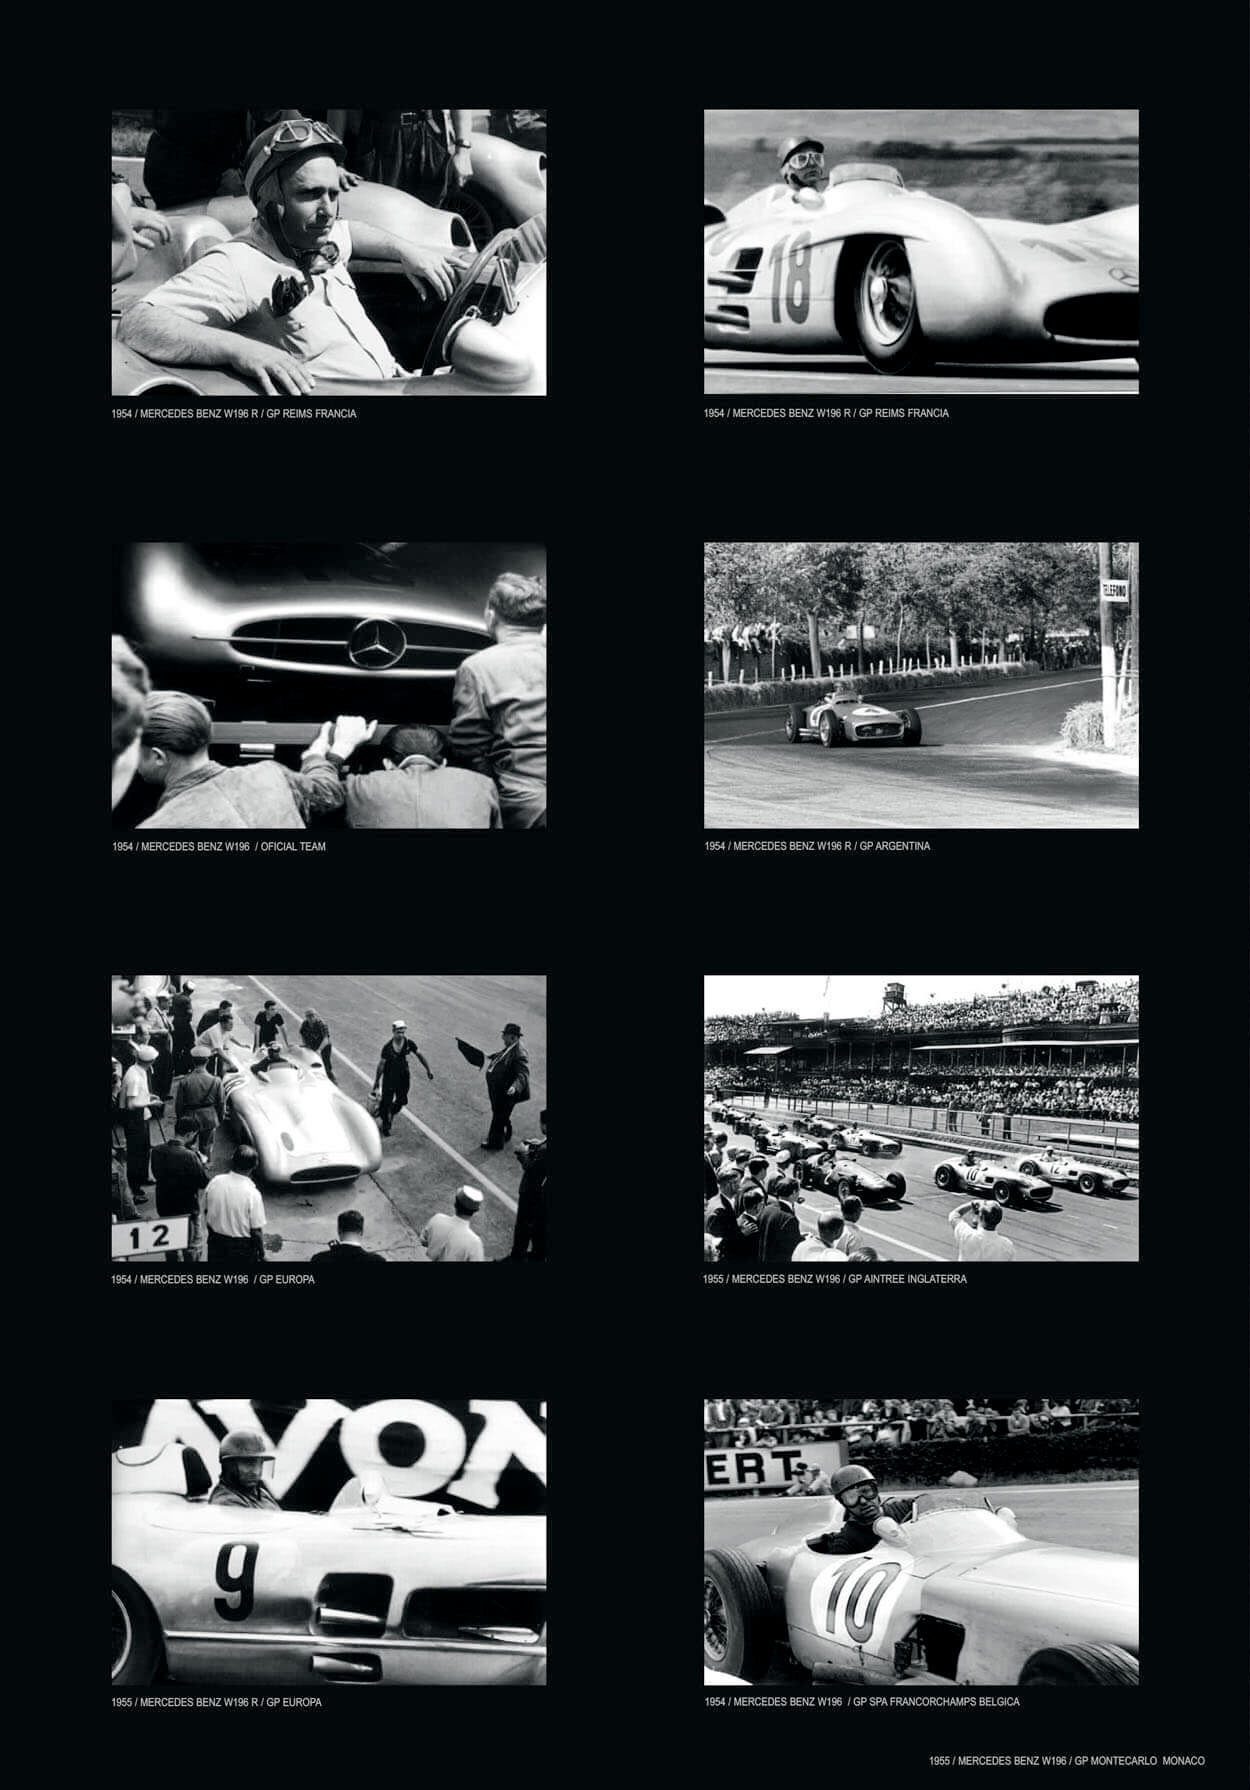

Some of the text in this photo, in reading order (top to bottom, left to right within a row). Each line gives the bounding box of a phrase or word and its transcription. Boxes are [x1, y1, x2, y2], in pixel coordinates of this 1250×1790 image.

[769, 231, 812, 325] 18
[966, 1167, 980, 1181] 10
[706, 1450, 802, 1485] ERT
[213, 1541, 260, 1622] 9
[826, 1556, 902, 1644] 10
